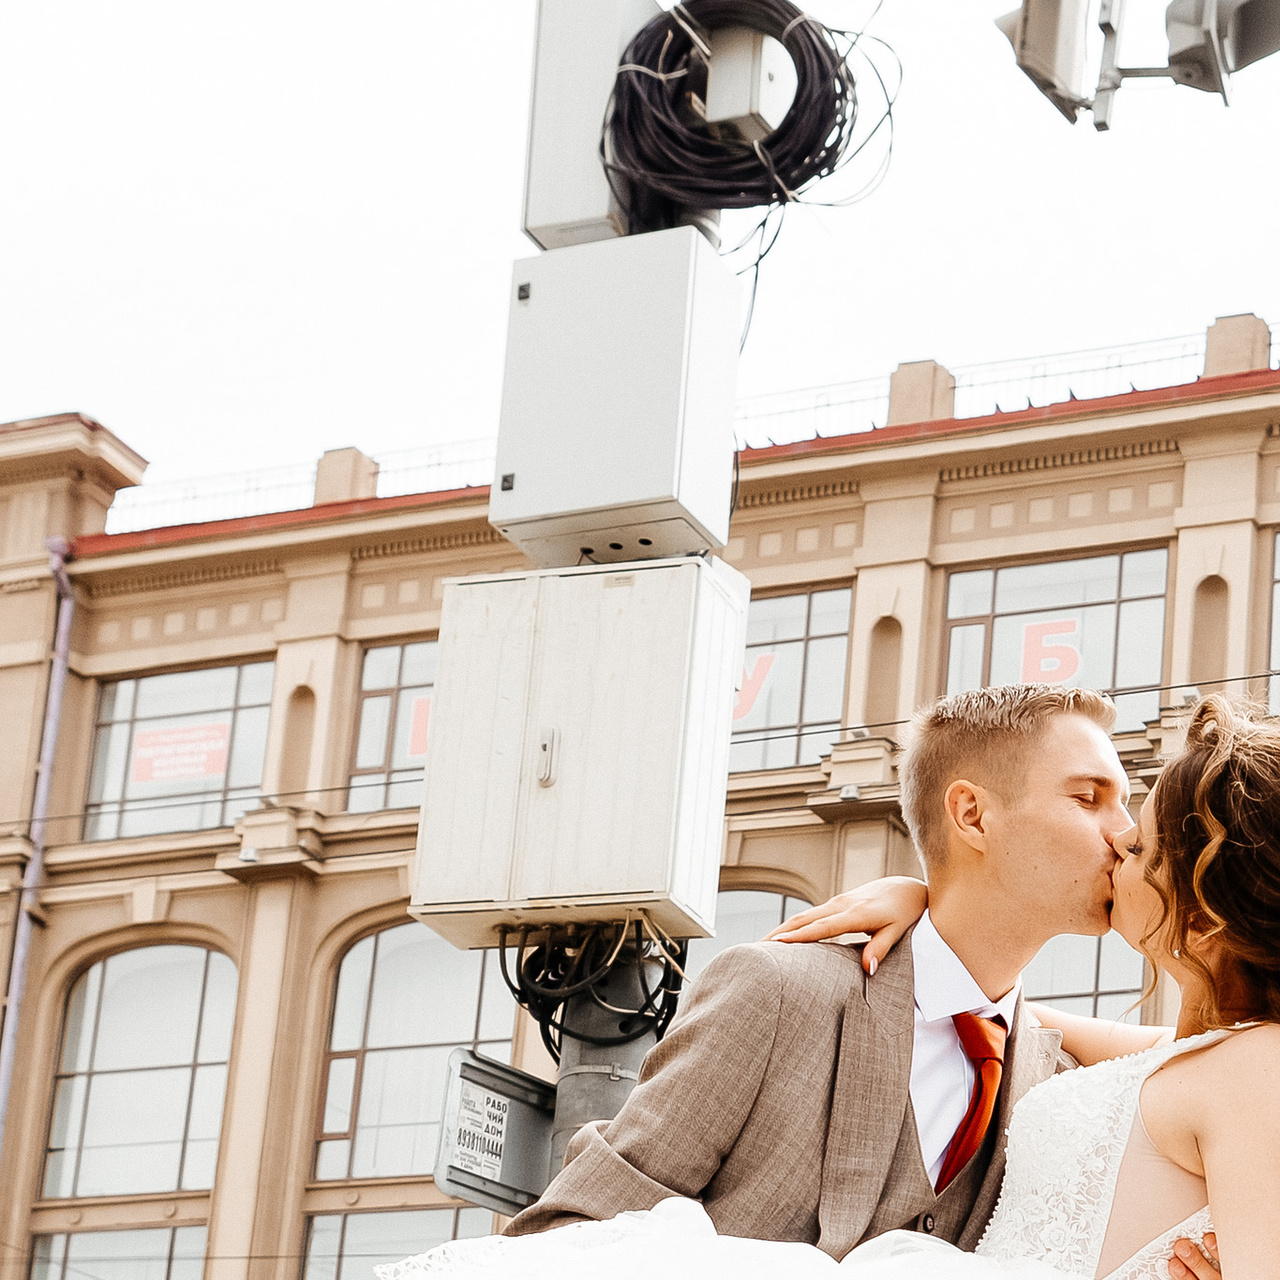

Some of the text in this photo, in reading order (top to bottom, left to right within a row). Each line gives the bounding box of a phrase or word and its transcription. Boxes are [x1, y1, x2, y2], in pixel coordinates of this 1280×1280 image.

[486, 1096, 508, 1114] РАБО
[487, 1110, 504, 1126] ЧИЙ
[484, 1123, 503, 1139] ДОМ
